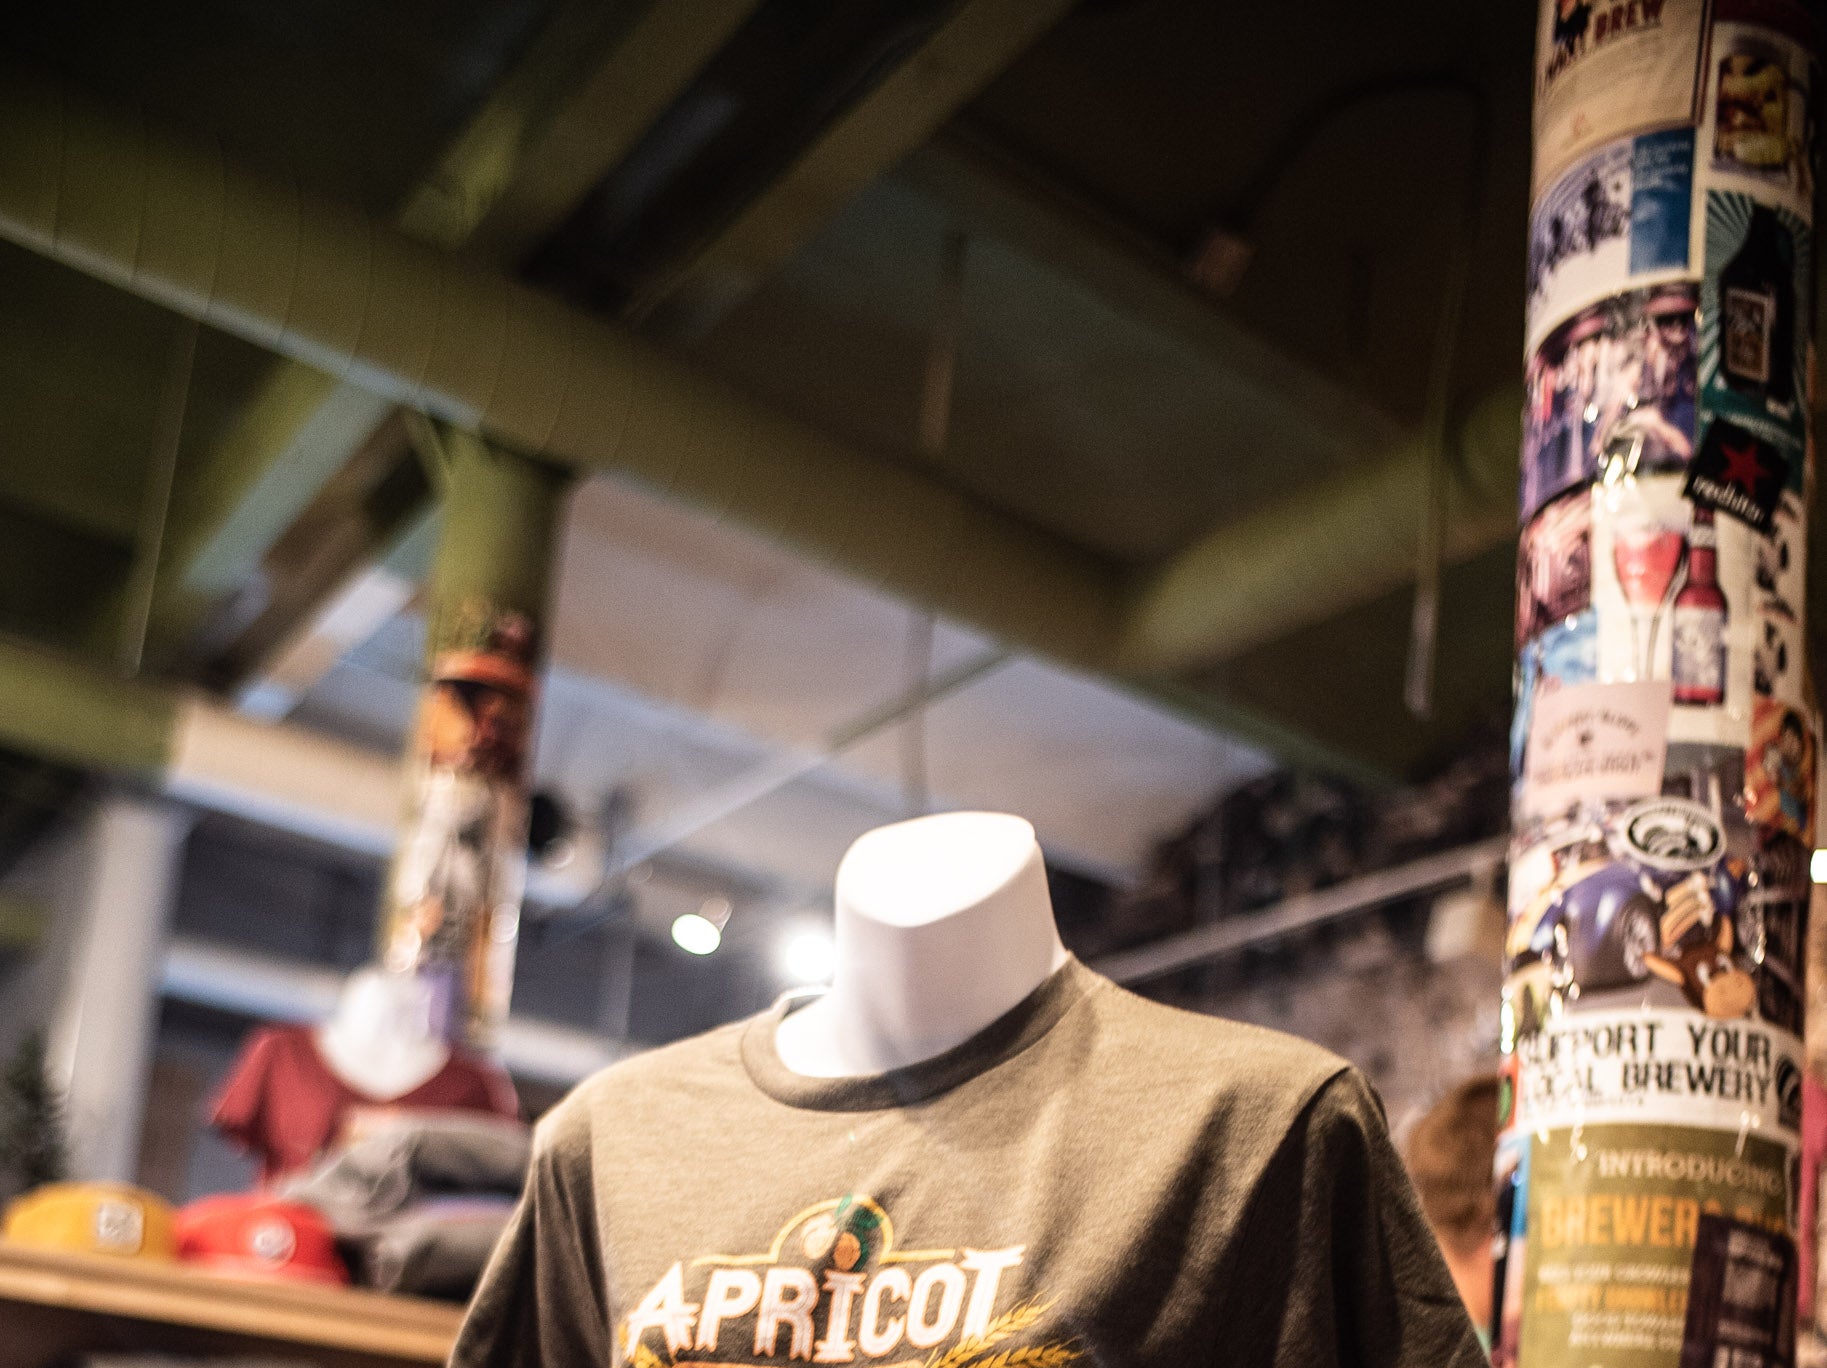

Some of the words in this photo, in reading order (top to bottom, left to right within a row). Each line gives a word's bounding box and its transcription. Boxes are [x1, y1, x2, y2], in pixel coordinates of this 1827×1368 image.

[1688, 1022, 1771, 1069] YOUR
[1622, 1060, 1772, 1107] BREWERY
[1541, 1193, 1722, 1247] BREWER
[624, 1244, 1027, 1364] APRICOT
